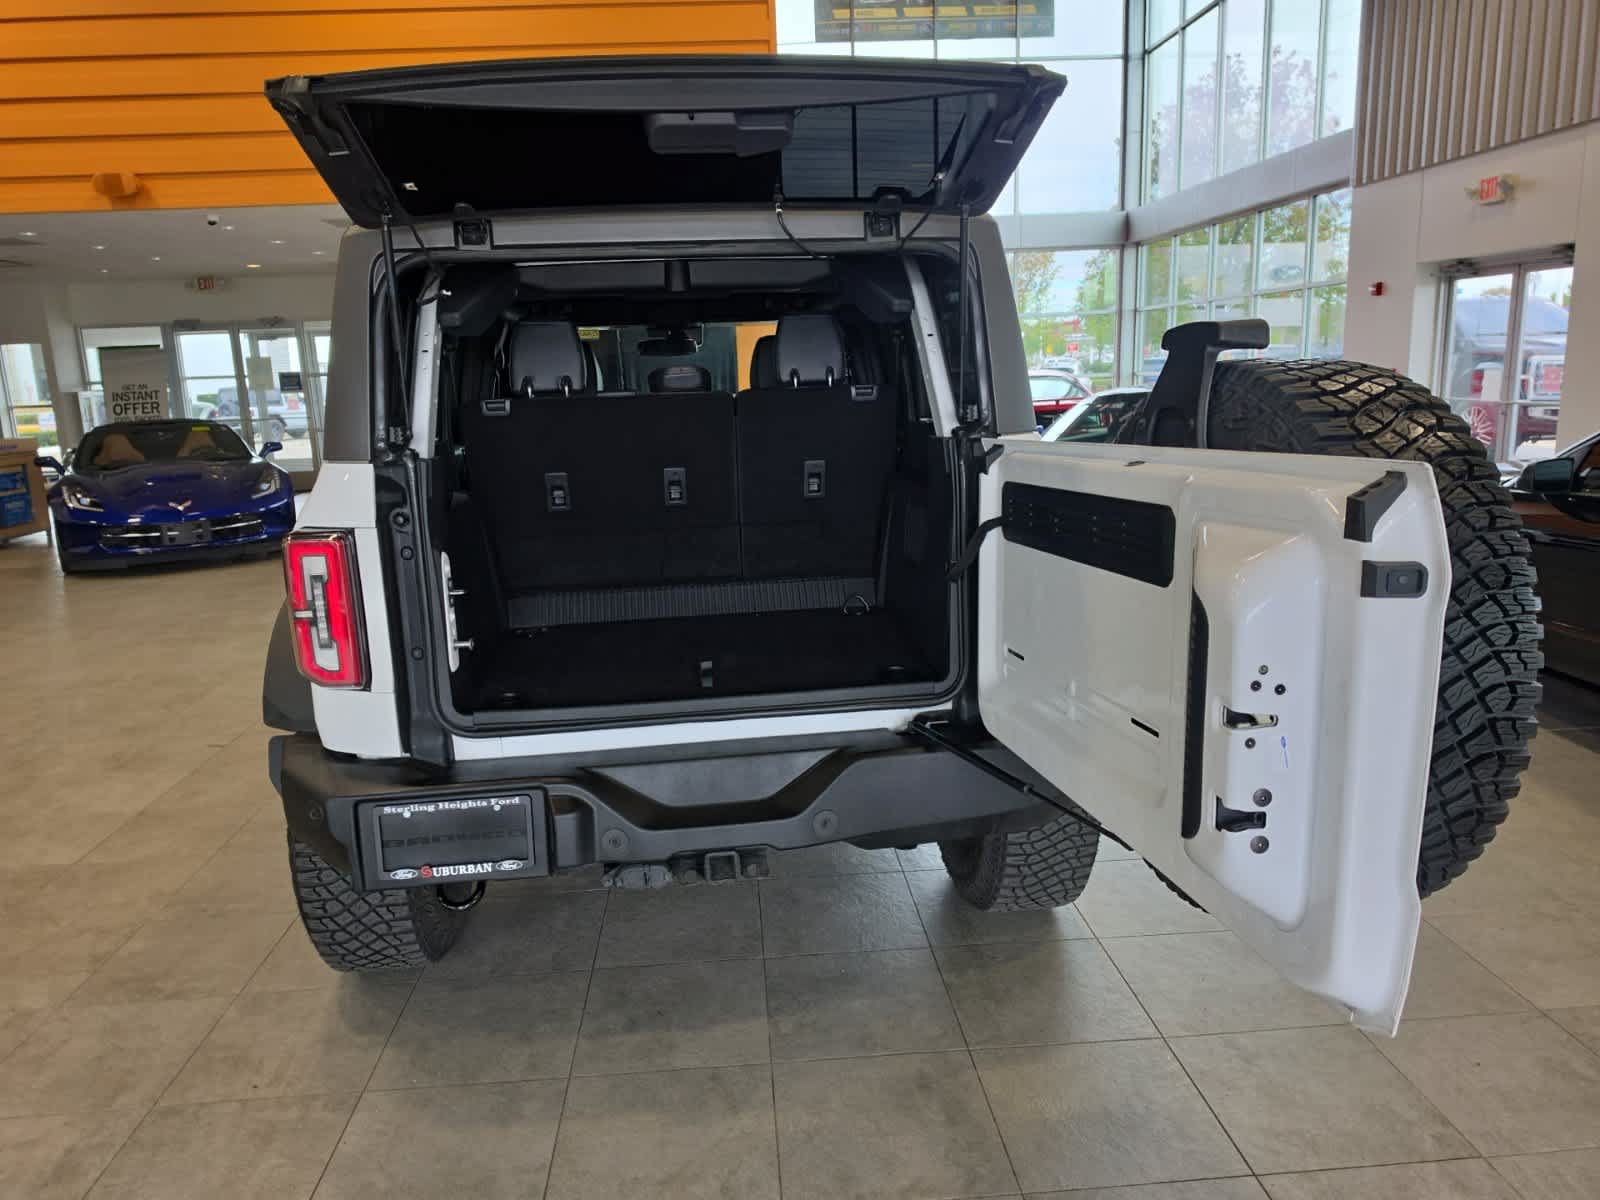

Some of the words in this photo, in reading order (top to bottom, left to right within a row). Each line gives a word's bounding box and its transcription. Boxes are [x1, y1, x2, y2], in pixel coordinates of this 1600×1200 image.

[112, 390, 161, 402] INSTANT
[112, 401, 161, 416] OFFER
[383, 803, 436, 815] Sterling
[438, 800, 488, 810] Heights
[490, 796, 520, 806] Ford
[421, 862, 493, 878] SUBURBAN
